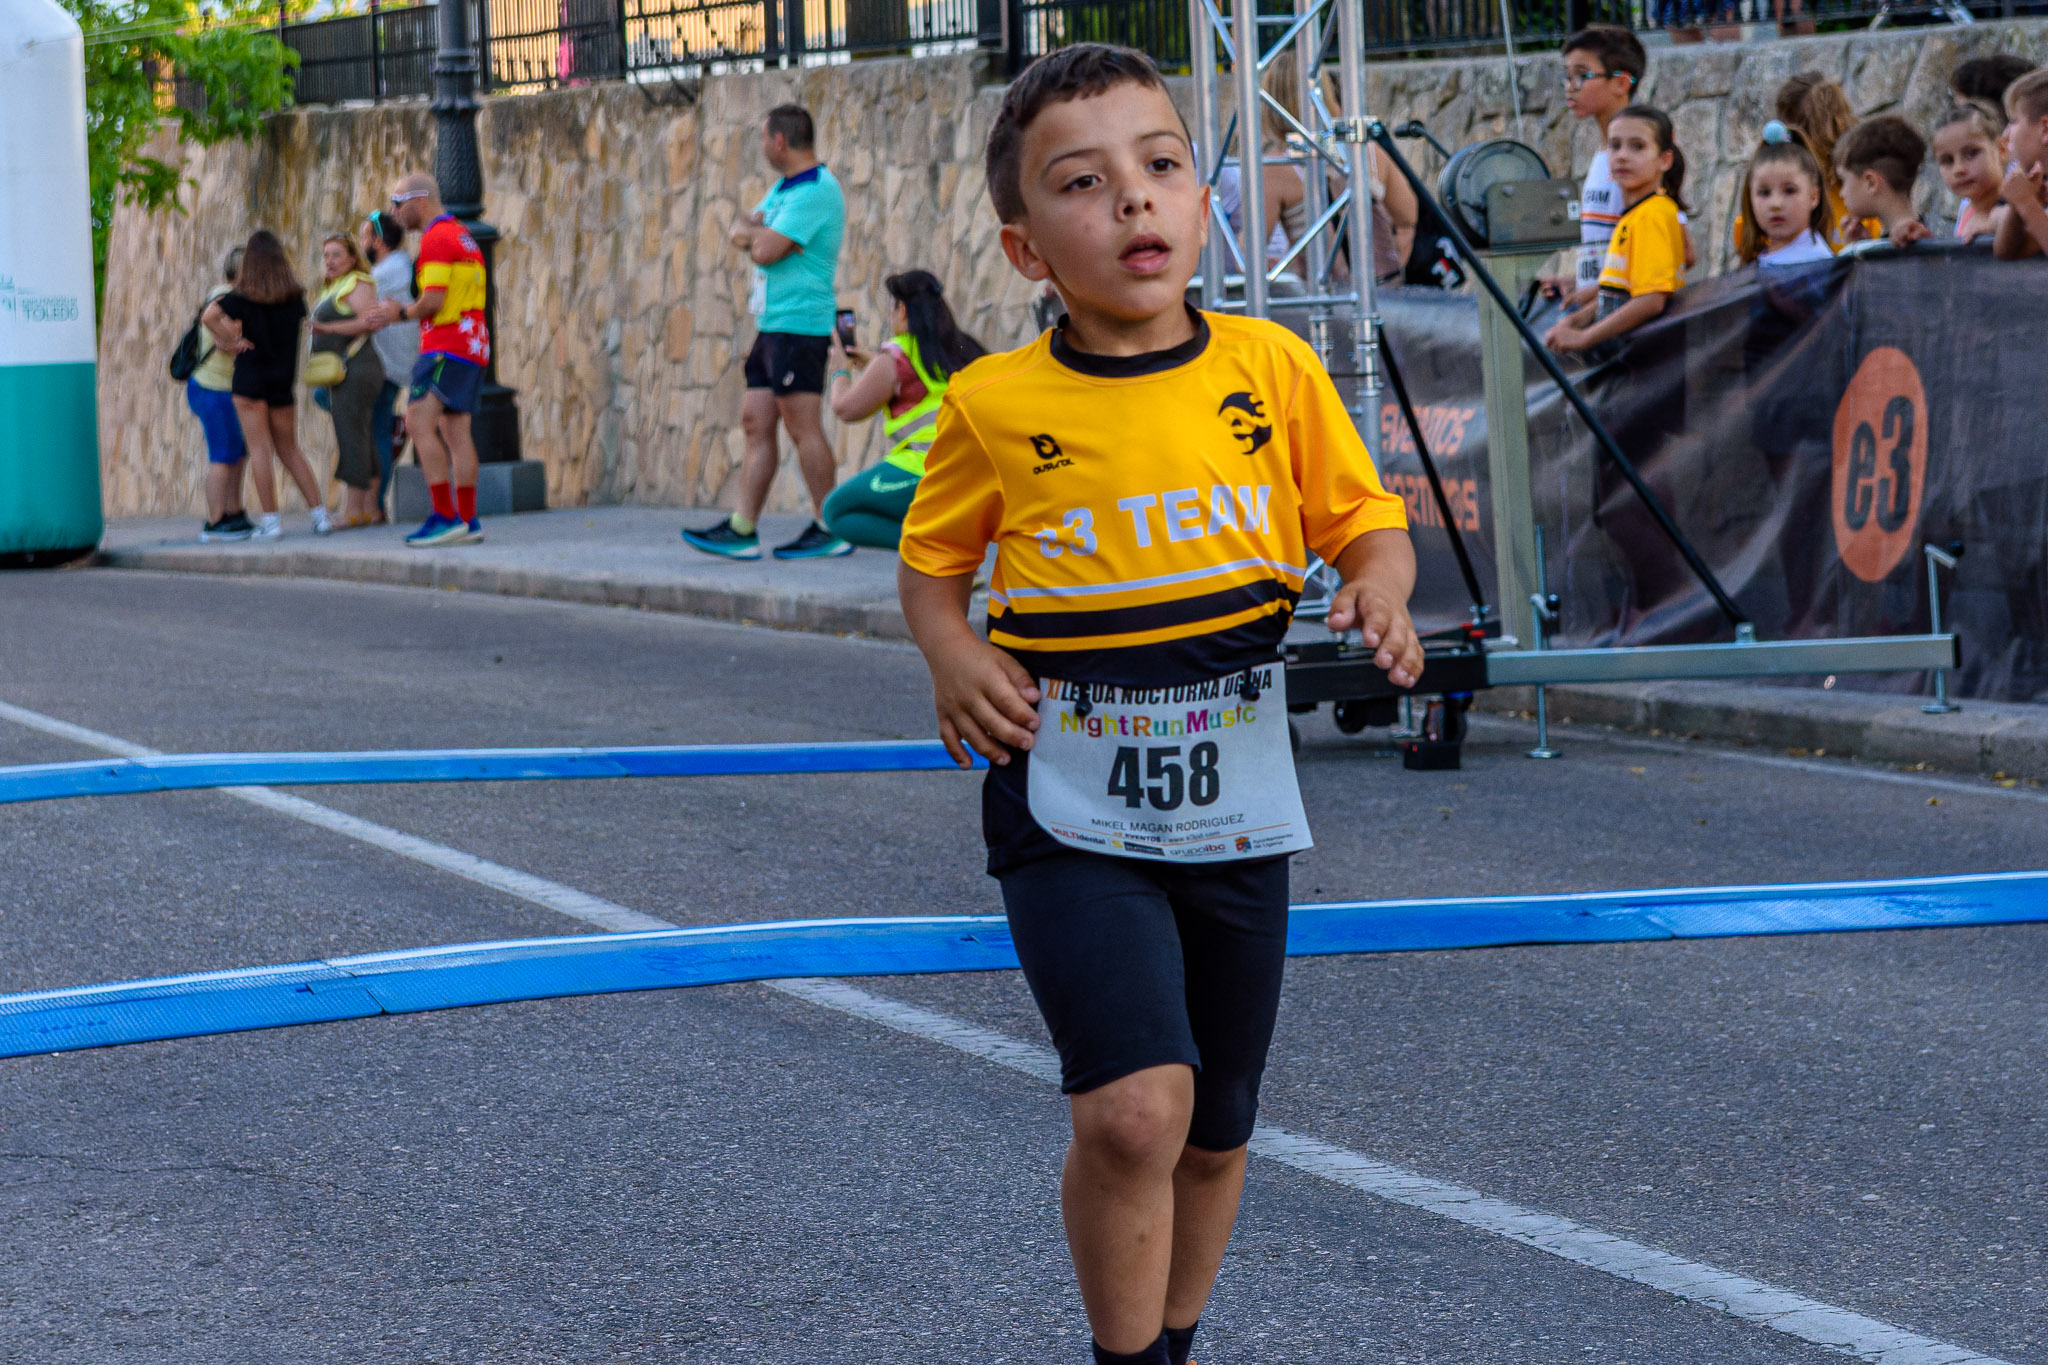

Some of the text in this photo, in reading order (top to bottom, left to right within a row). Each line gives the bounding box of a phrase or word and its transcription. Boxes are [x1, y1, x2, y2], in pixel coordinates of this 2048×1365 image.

[1845, 396, 1915, 533] e3
[1117, 484, 1271, 548] TEAM
[1061, 680, 1116, 704] LEUA
[1121, 679, 1220, 705] NOCTURNA
[1223, 669, 1272, 697] UGNA
[1107, 741, 1220, 811] 458
[1091, 813, 1245, 833] MIKEL MAGAN RODRIGUEZ
